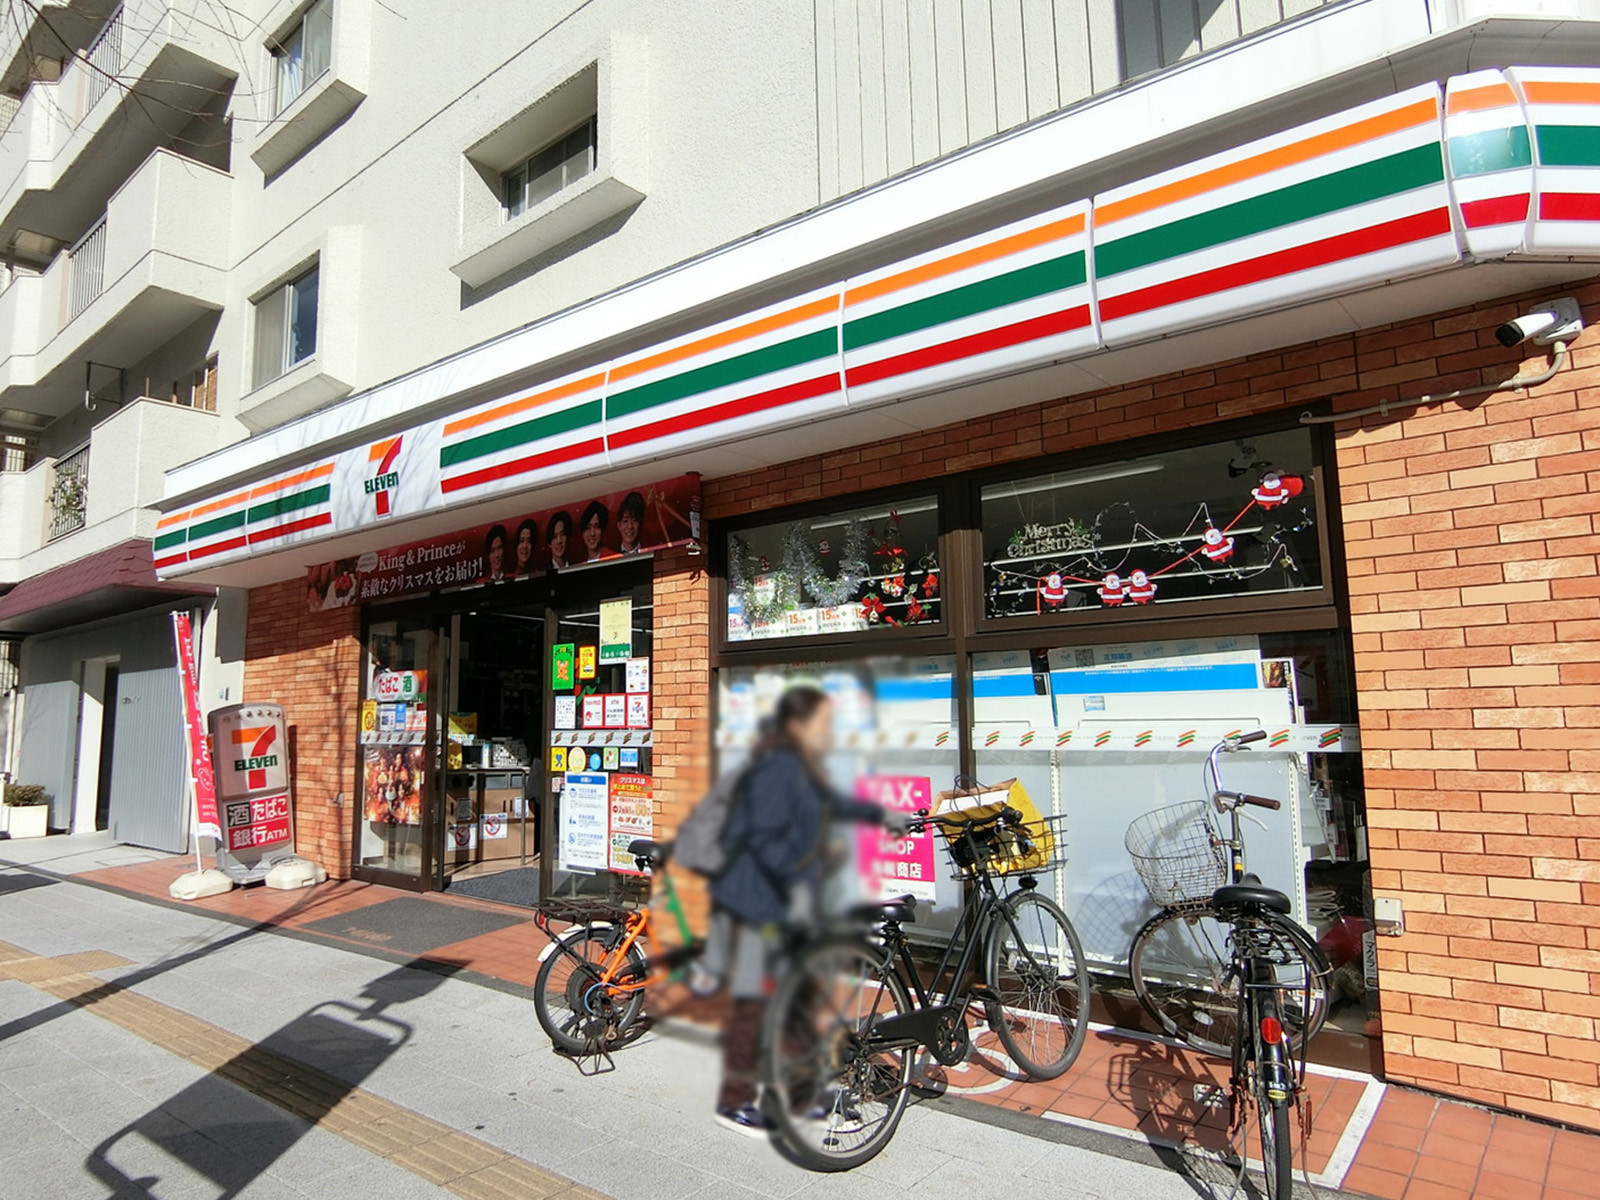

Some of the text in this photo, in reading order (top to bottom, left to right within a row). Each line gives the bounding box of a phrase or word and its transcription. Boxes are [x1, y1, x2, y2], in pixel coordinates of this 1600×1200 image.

[368, 434, 404, 519] 7
[1021, 518, 1075, 541] Merry
[378, 553, 406, 573] King
[405, 551, 416, 565] &
[377, 675, 413, 694] たばこ 酒
[231, 724, 277, 789] 7
[228, 804, 250, 827] 酒
[252, 798, 288, 822] たばこ
